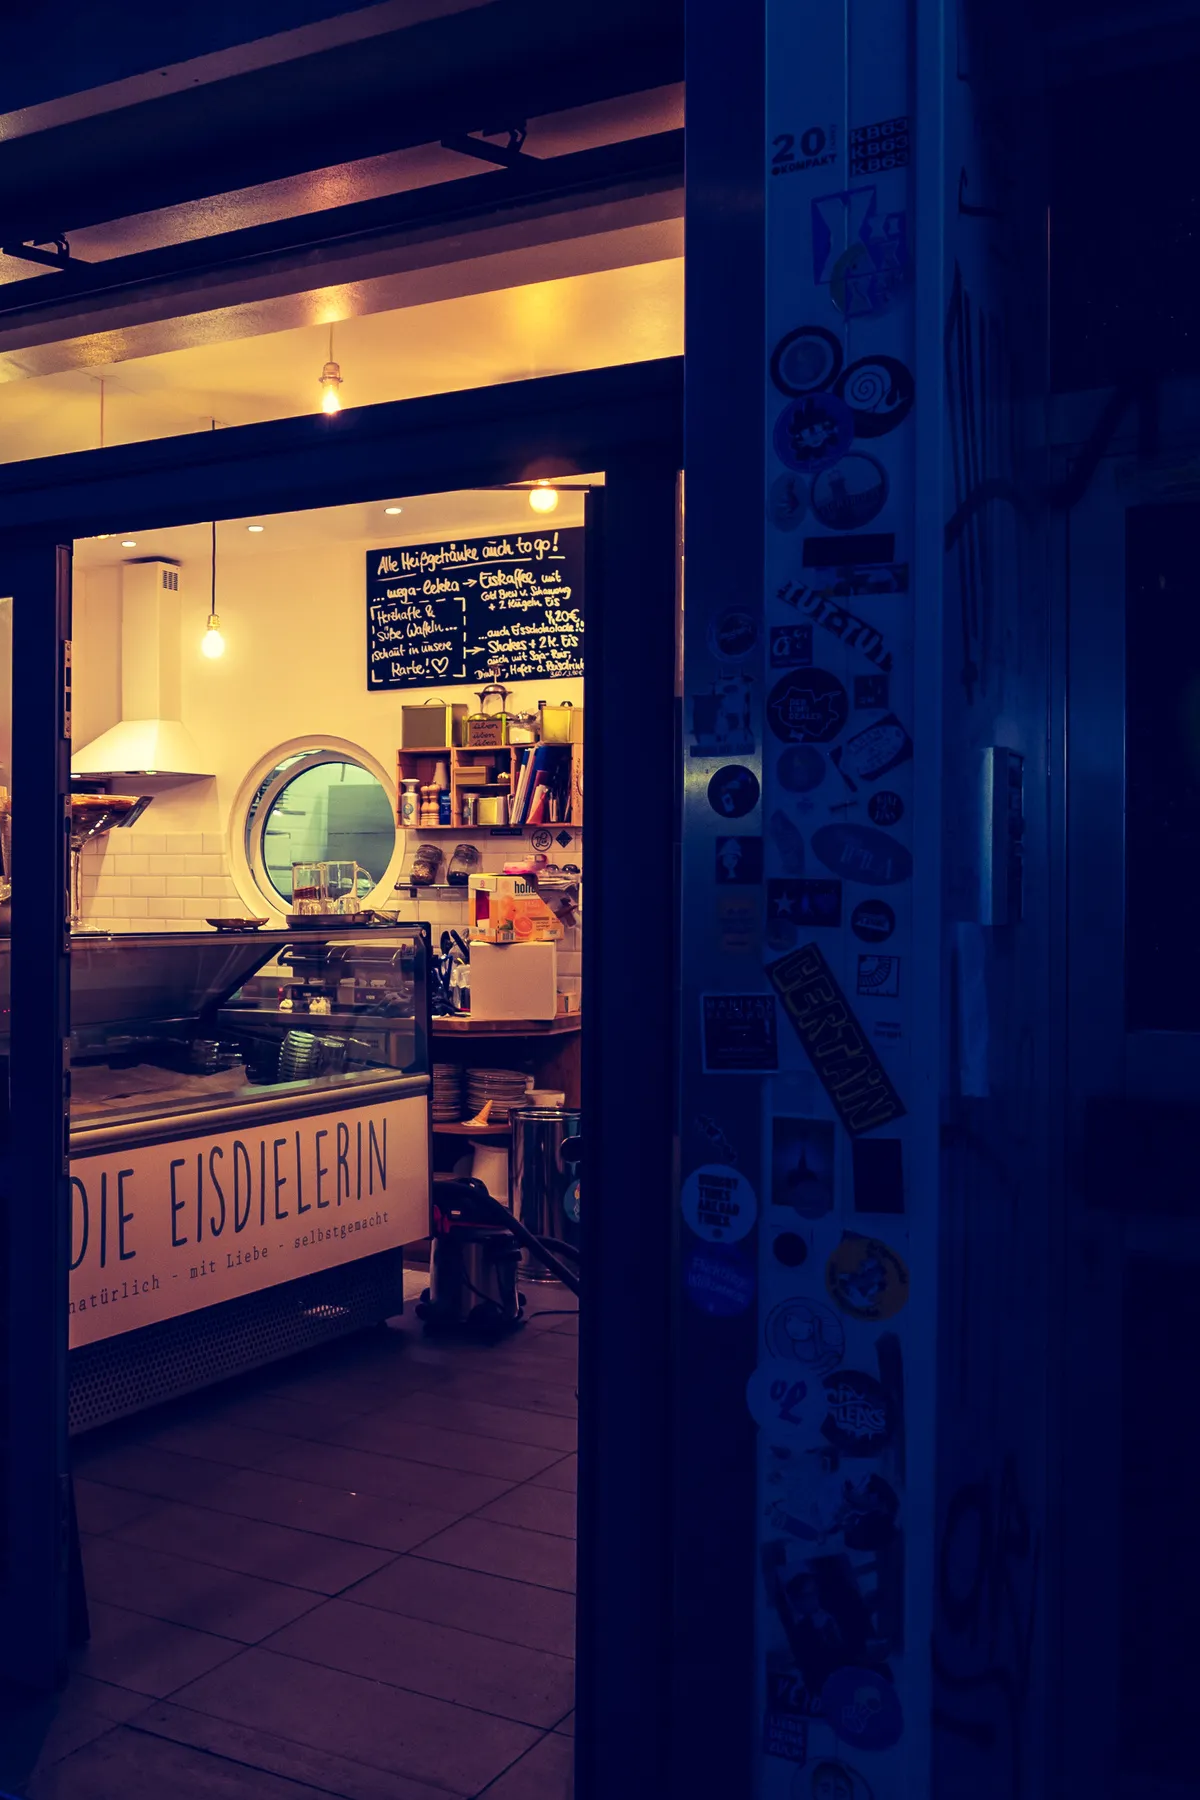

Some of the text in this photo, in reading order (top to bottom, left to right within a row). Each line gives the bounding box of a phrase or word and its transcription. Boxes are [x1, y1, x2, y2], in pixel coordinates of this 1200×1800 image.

[851, 118, 908, 144] KB63
[771, 126, 826, 164] 20
[851, 135, 908, 160] KB63
[851, 152, 908, 176] KB63
[377, 556, 400, 575] Alle
[401, 544, 479, 573] Heißgetränke
[516, 536, 532, 554] to
[534, 532, 559, 560] go!
[480, 568, 562, 589] Eiskaffee mit
[499, 600, 506, 610] 2
[544, 594, 560, 607] Eis
[377, 604, 436, 626] Herzhafte &
[409, 643, 419, 656] in
[421, 641, 453, 654] unsere
[488, 638, 528, 654] Shakes
[560, 634, 579, 648] Eis
[392, 658, 430, 678] Karte!
[512, 652, 528, 662] mit
[69, 1117, 388, 1271] DIE EISDIELERIN
[69, 1275, 160, 1314] natürlich
[190, 1259, 216, 1279] mit
[226, 1246, 269, 1269] Liebe
[294, 1211, 389, 1249] selbstgemacht
